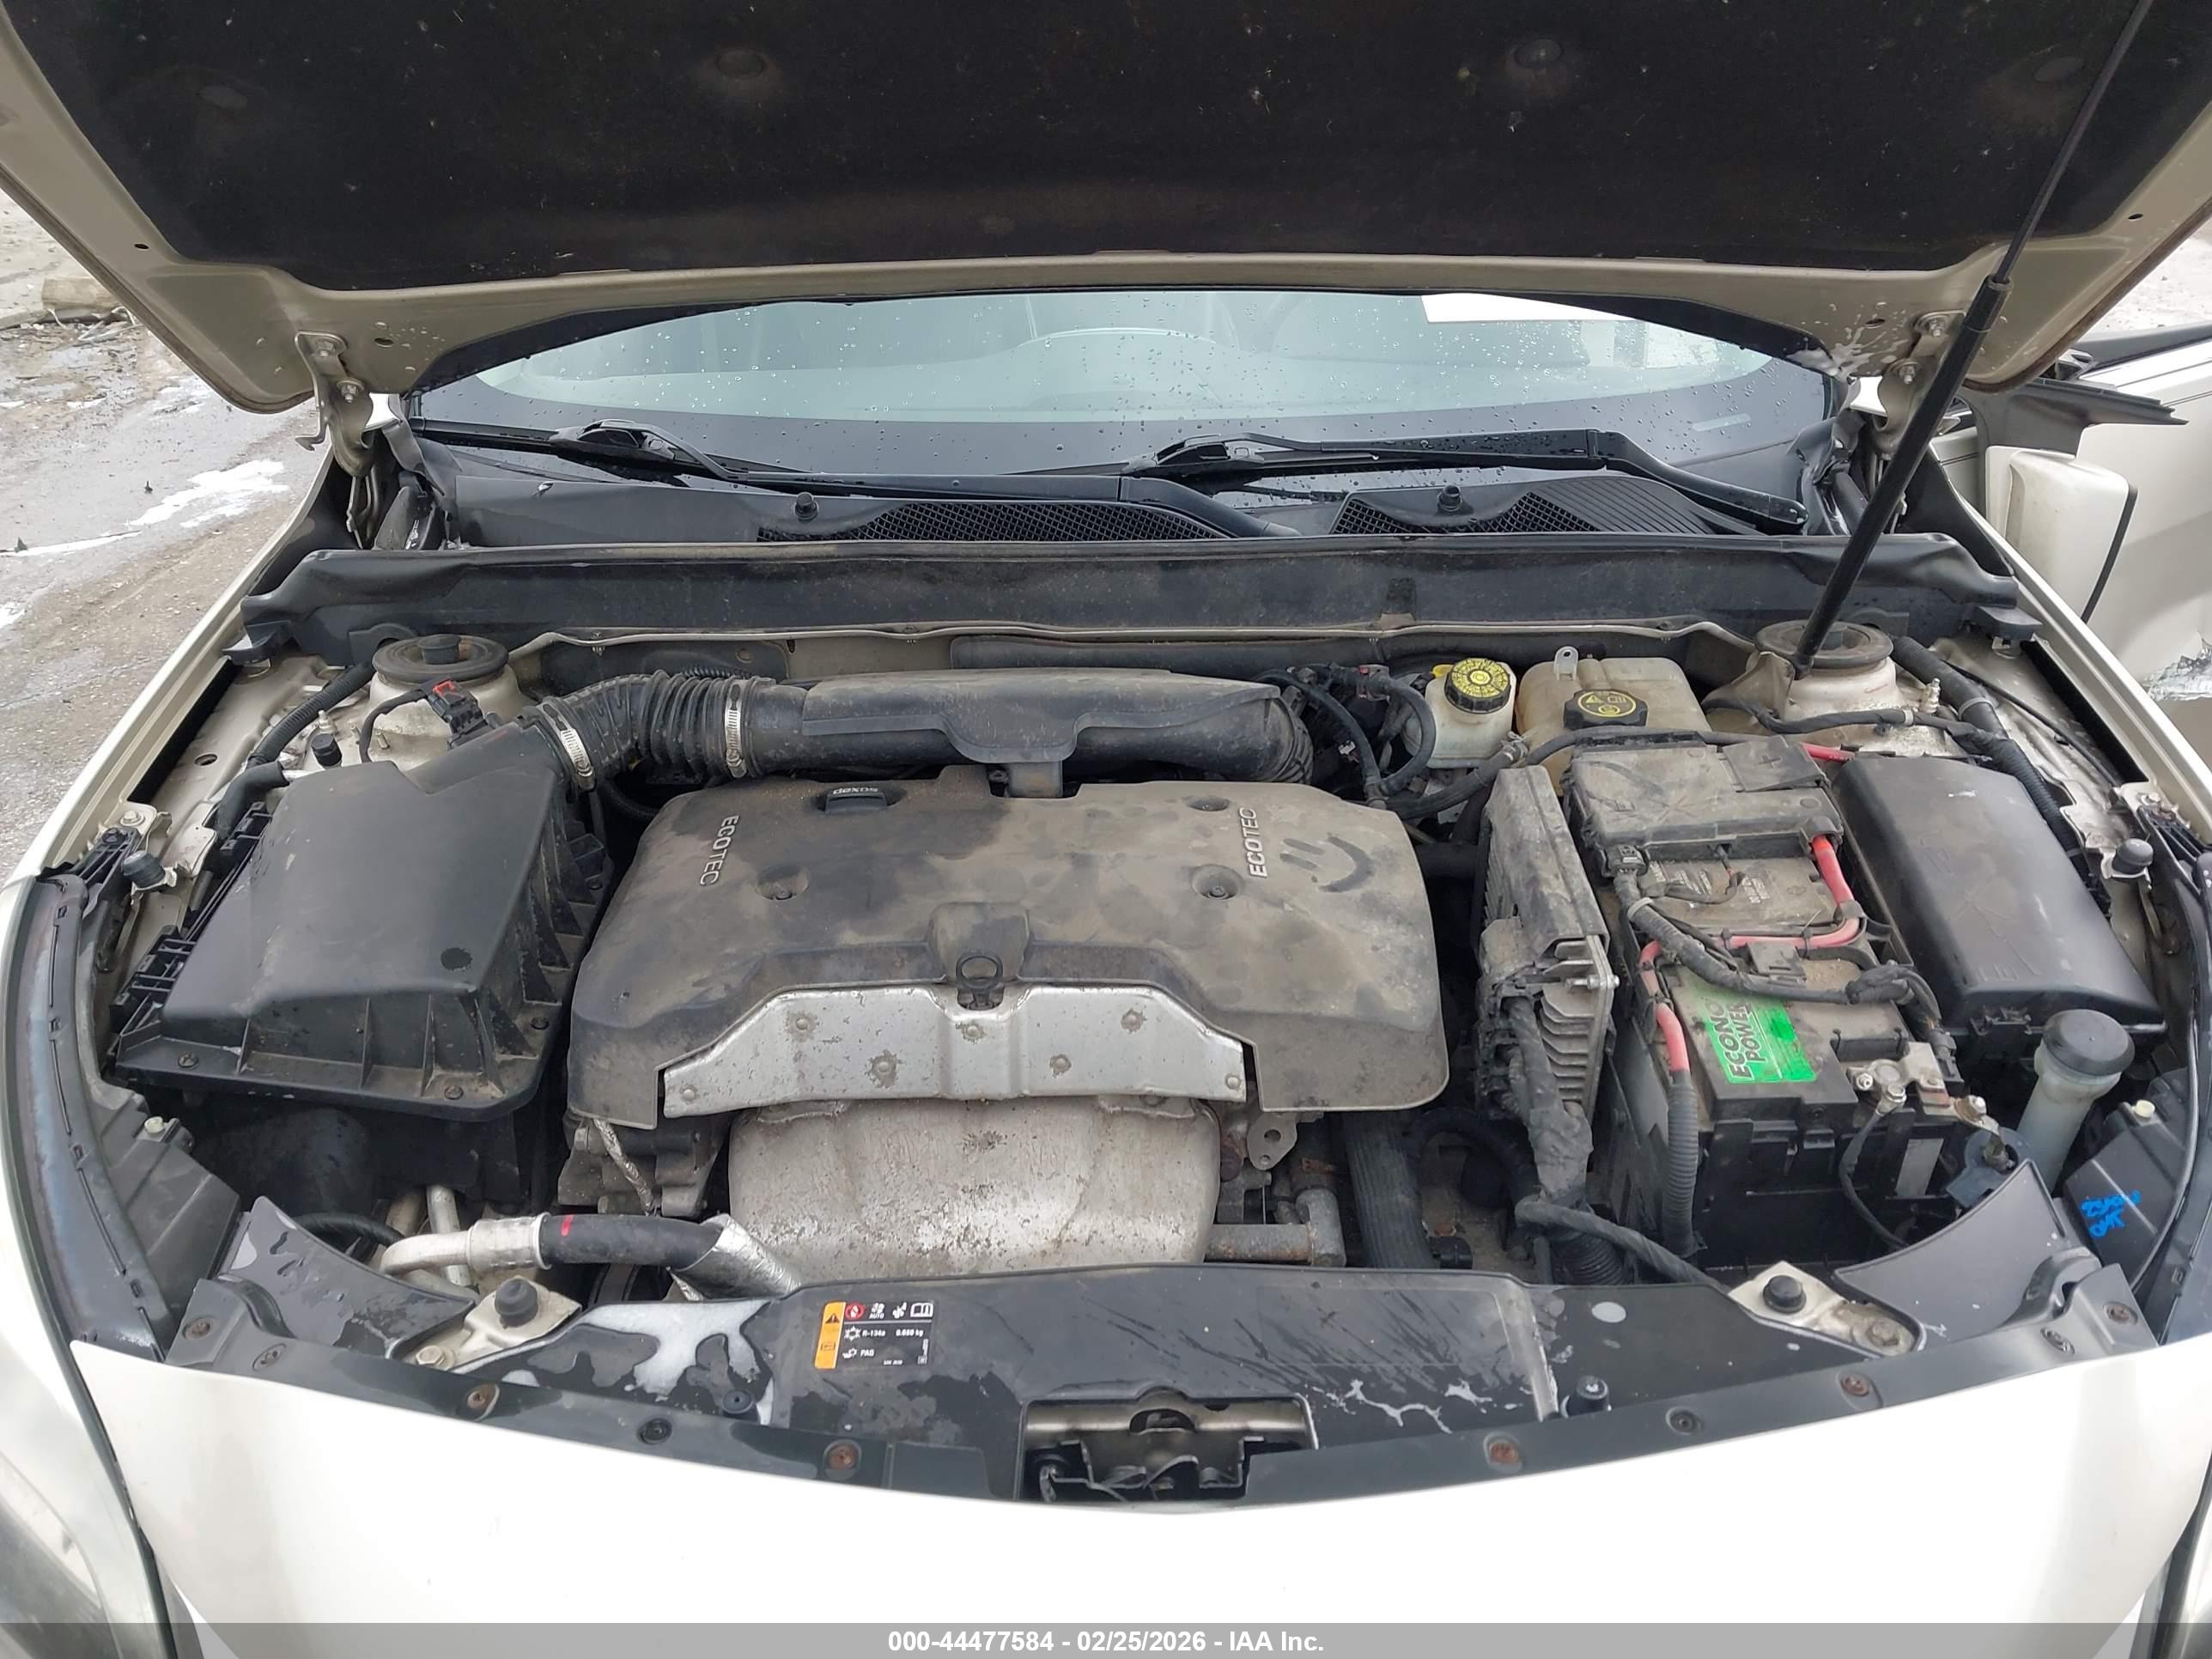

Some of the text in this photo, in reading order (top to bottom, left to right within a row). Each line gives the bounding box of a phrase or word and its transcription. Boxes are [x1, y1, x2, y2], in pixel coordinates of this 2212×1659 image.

[700, 815, 739, 886] ECOTEC
[1237, 806, 1268, 878] ECOTEC
[860, 1348, 875, 1358] PAG
[861, 1328, 886, 1337] R-134a
[915, 1328, 924, 1338] kg
